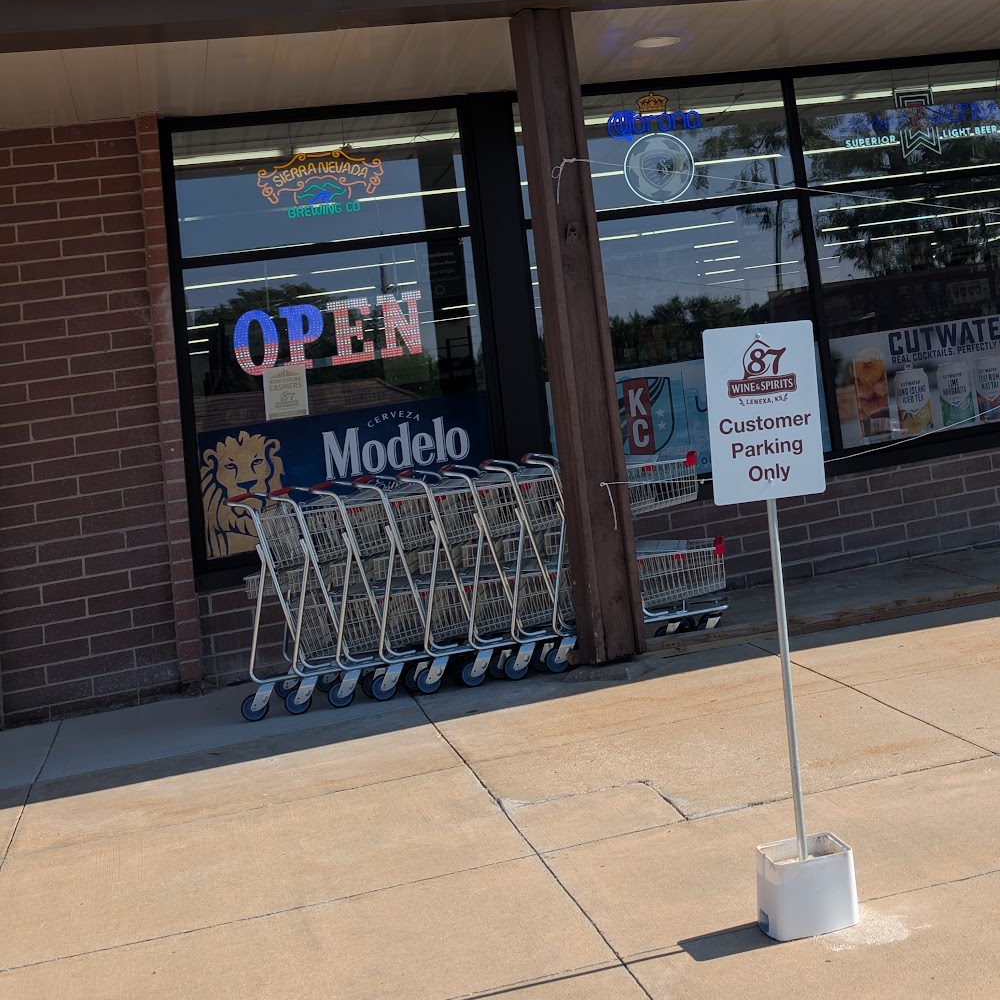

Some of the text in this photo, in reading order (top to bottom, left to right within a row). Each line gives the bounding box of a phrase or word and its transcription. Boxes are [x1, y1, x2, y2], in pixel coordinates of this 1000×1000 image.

[607, 109, 702, 142] Corona
[845, 125, 998, 149] SUPERIOR LIGHT BEER
[272, 161, 368, 187] SIERRA NEVADA
[287, 201, 361, 219] BREWING CO
[233, 290, 422, 376] OPEN
[747, 346, 787, 375] 87
[891, 354, 911, 365] REAL
[912, 348, 956, 361] COCKTAILS.
[957, 340, 999, 355] PERFECTLY
[268, 381, 303, 392] CASHIERS
[746, 397, 774, 405] LENEXA,
[366, 410, 421, 428] CERVEZA
[719, 412, 812, 435] Customer
[321, 416, 470, 481] Modelo
[731, 438, 803, 459] Parking
[748, 463, 791, 482] Only
